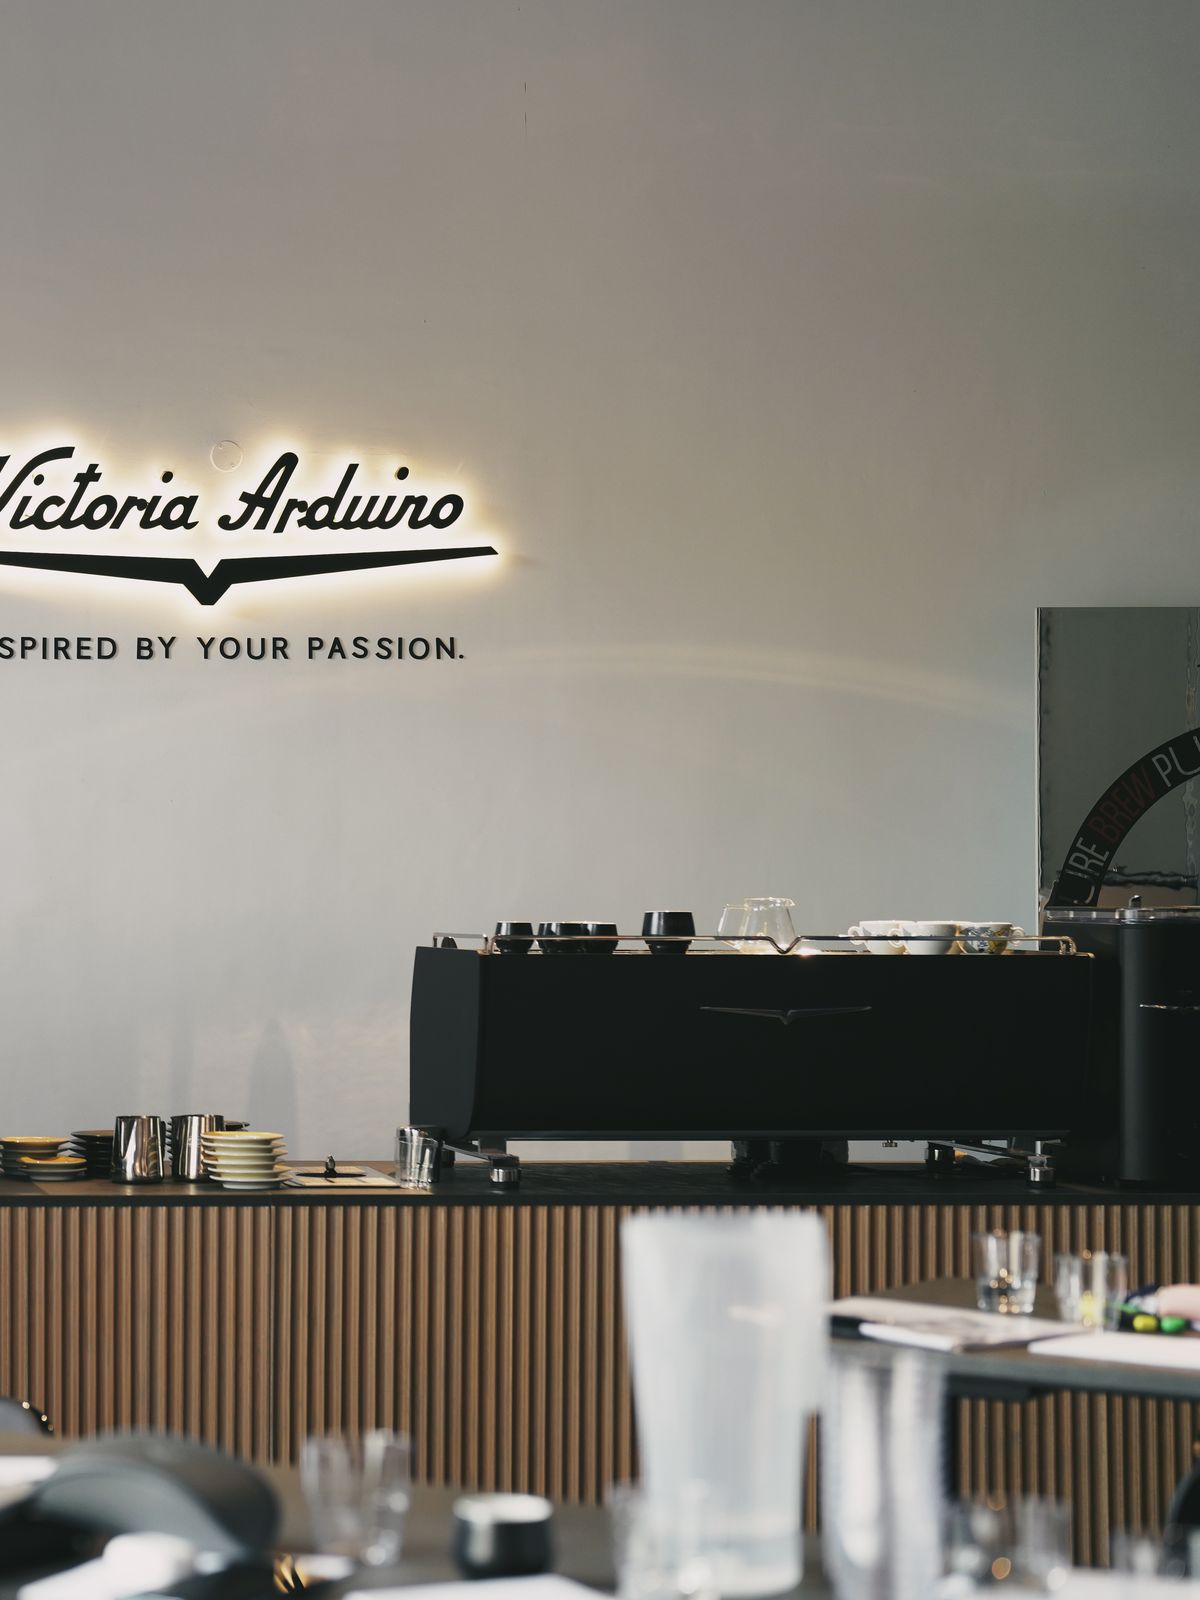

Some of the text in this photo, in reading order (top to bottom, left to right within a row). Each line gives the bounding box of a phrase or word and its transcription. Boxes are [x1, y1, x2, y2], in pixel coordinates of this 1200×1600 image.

[217, 452, 464, 535] Arduino
[136, 637, 177, 661] BY
[196, 637, 289, 661] YOUR
[307, 637, 465, 661] PASSION.
[1087, 766, 1158, 844] BREW
